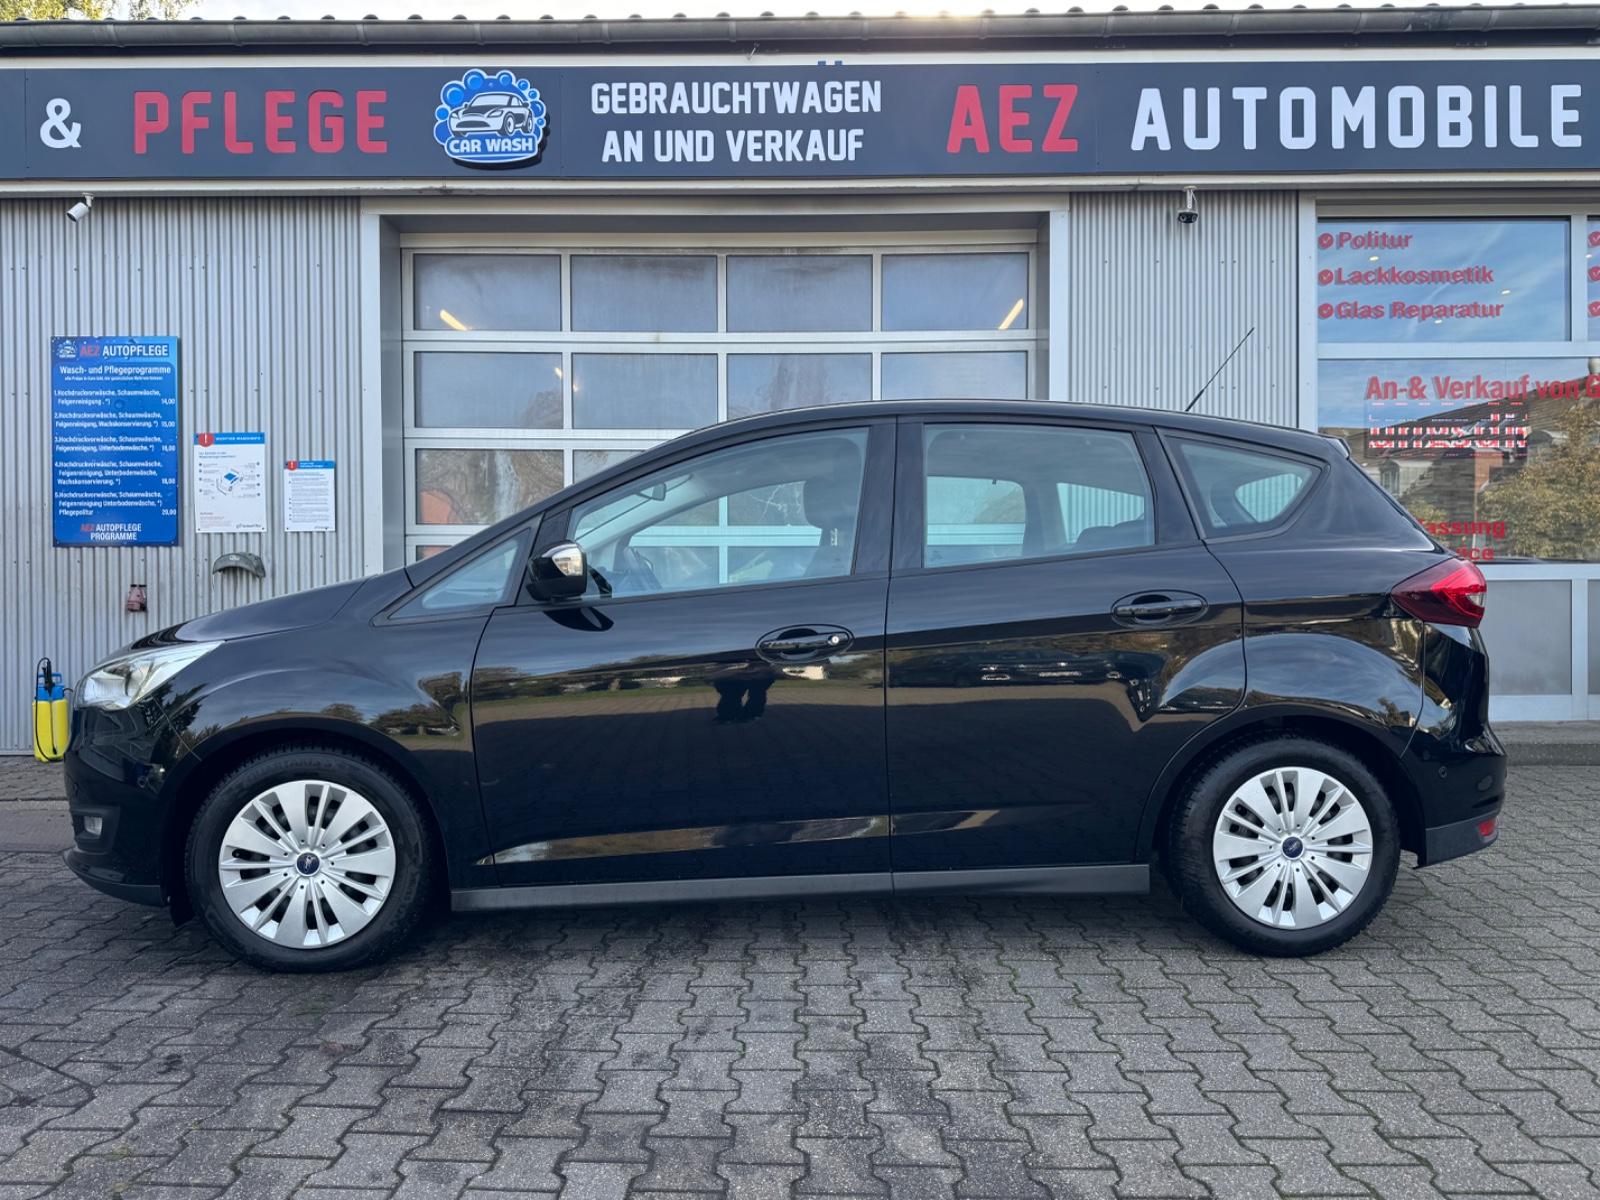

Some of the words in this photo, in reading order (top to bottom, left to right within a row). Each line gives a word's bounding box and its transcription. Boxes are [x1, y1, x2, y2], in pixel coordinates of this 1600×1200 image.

[591, 81, 882, 114] GEBRAUCHTWAGEN
[40, 98, 82, 149] &
[133, 90, 389, 155] PFLEGE
[947, 84, 1079, 153] AEZ
[1131, 84, 1582, 150] AUTOMOBILE
[449, 140, 482, 153] CAR
[485, 138, 533, 152] WASH
[601, 130, 644, 162] AN
[654, 130, 715, 162] UND
[726, 129, 865, 162] VERKAUF
[1336, 231, 1414, 250] Politur
[1335, 266, 1494, 285] Lackkosmetik
[1335, 301, 1385, 319] Glas
[1389, 302, 1504, 322] Reparatur
[81, 345, 100, 356] AEZ
[102, 345, 169, 357] AUTOPFLEGE
[60, 366, 88, 375] Wasch-
[88, 365, 103, 374] und
[104, 365, 171, 376] Pflegeprogramme
[1432, 374, 1529, 400] Verkauf
[1535, 379, 1579, 399] von
[91, 533, 138, 541] PROGRAMME
[96, 524, 142, 533] AUTOPFLEGE
